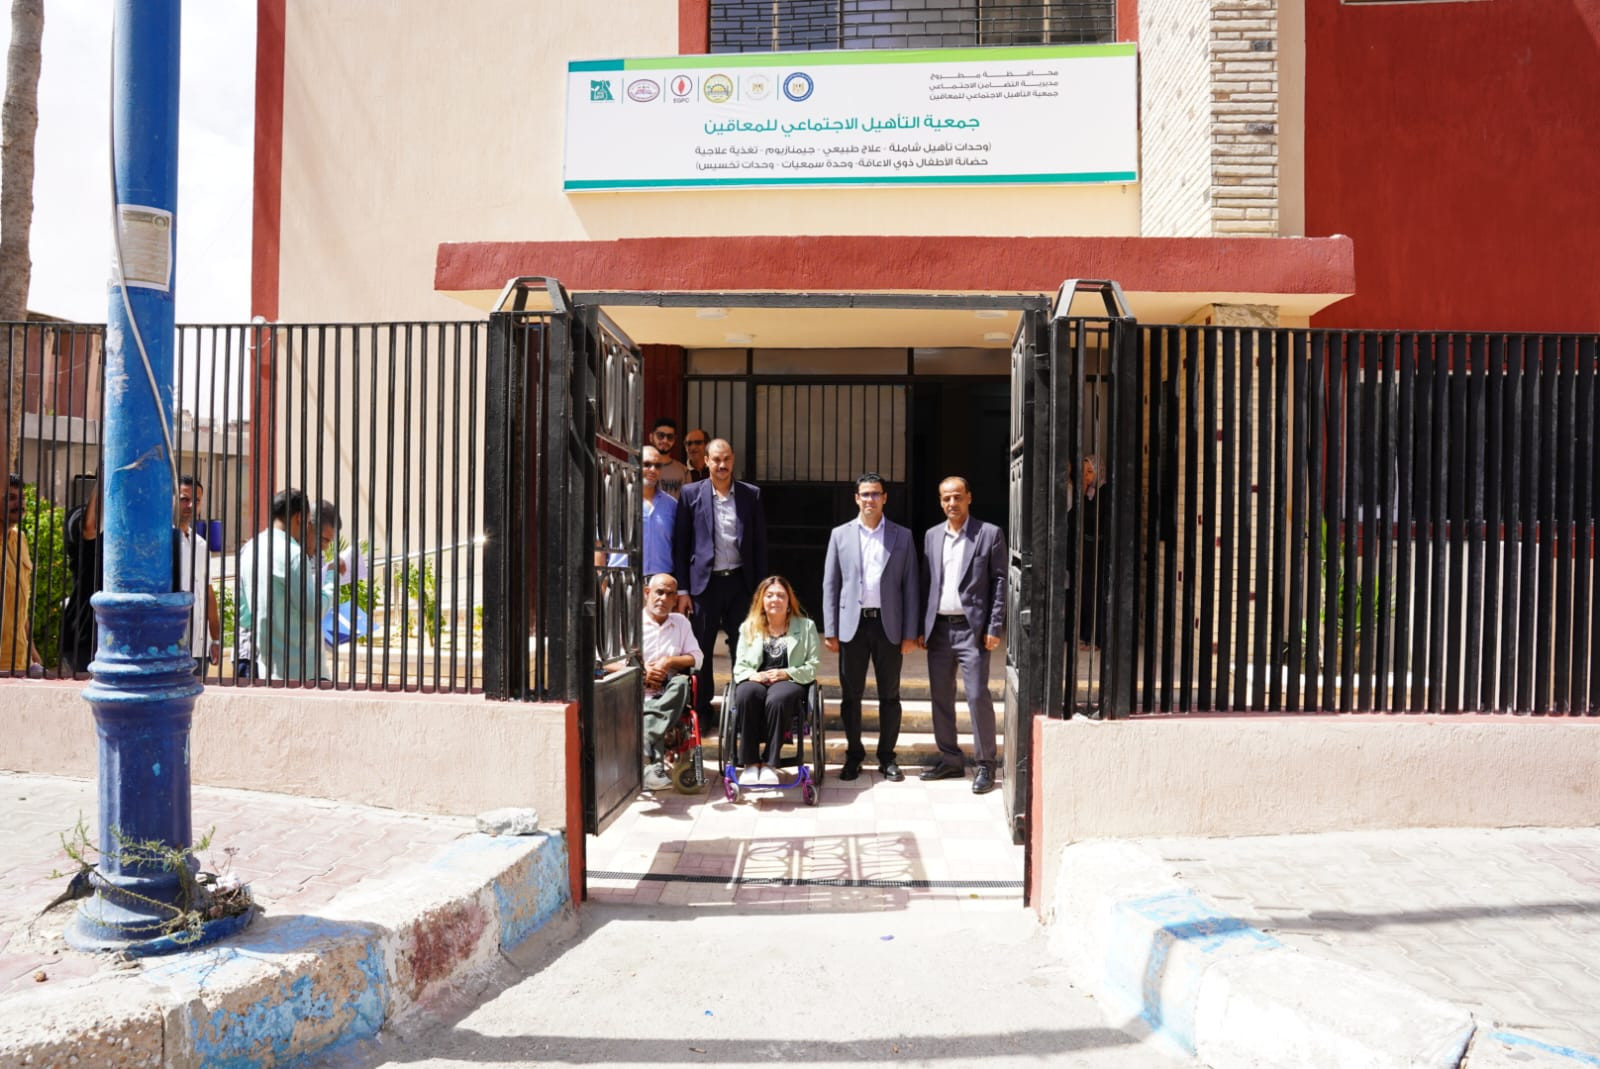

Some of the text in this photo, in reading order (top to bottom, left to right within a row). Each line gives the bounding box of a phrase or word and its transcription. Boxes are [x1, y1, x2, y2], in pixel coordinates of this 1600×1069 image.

[1032, 90, 1059, 98] جمعية
[704, 112, 980, 138] جمعية التأهيل الاجتماعي للمعاقين
[695, 146, 727, 156] علاجية
[729, 146, 758, 155] تغذية
[822, 145, 859, 157] طبيعي
[861, 144, 881, 154] علاج
[889, 142, 921, 153] شاملة
[742, 161, 775, 170] وحدات
[781, 161, 824, 170] سمعيات
[826, 160, 853, 169] وحدة
[893, 159, 914, 171] ذوي
[955, 157, 988, 166] حضانة
